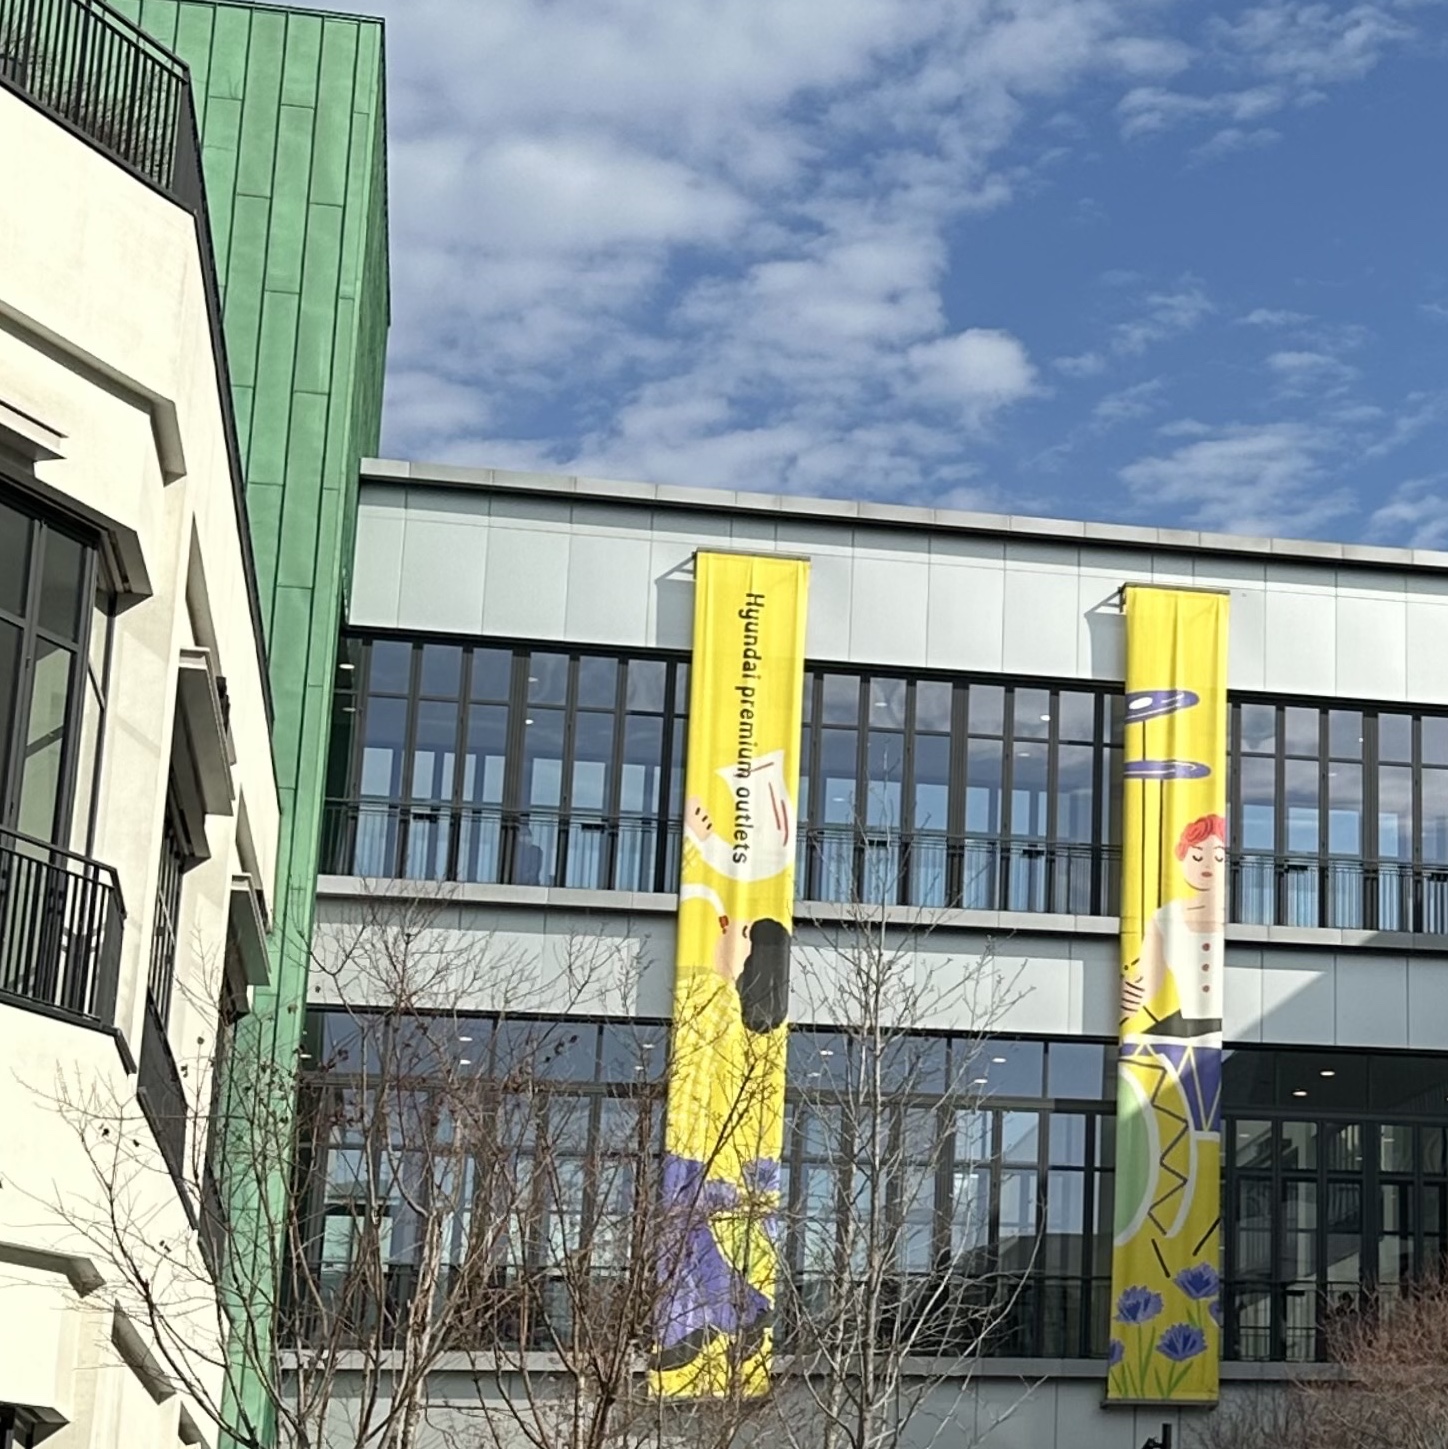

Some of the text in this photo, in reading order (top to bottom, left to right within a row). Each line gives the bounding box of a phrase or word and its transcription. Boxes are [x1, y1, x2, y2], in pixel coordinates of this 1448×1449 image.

[732, 593, 765, 864] Hyundai premium outlets
